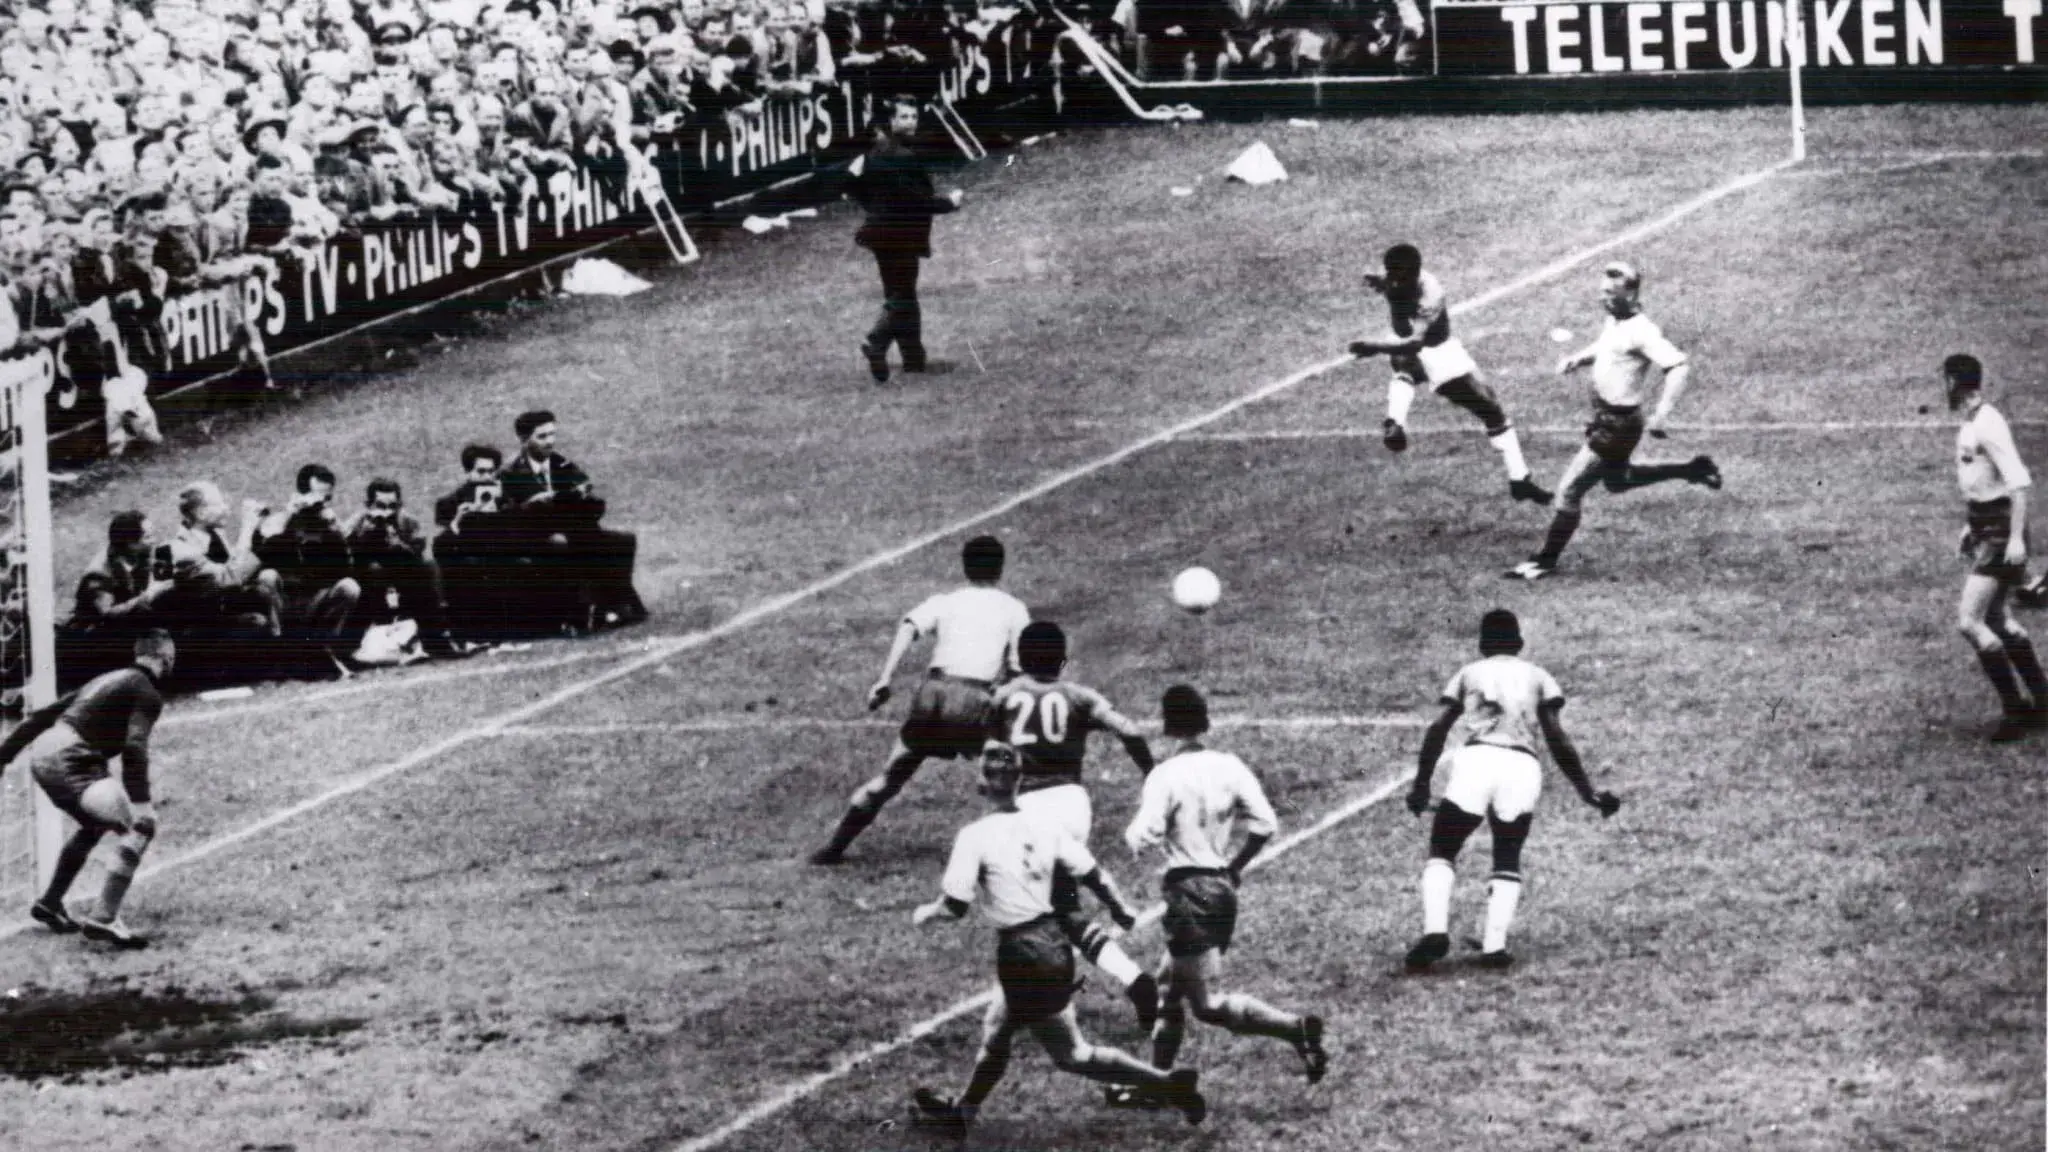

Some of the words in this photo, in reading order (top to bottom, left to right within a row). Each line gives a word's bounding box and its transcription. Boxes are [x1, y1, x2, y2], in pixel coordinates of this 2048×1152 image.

[1500, 0, 1945, 74] TELEFUNKEN
[2002, 0, 2043, 64] T
[289, 243, 339, 323] TV
[724, 93, 833, 177] PHILIPS
[1006, 691, 1069, 746] 20
